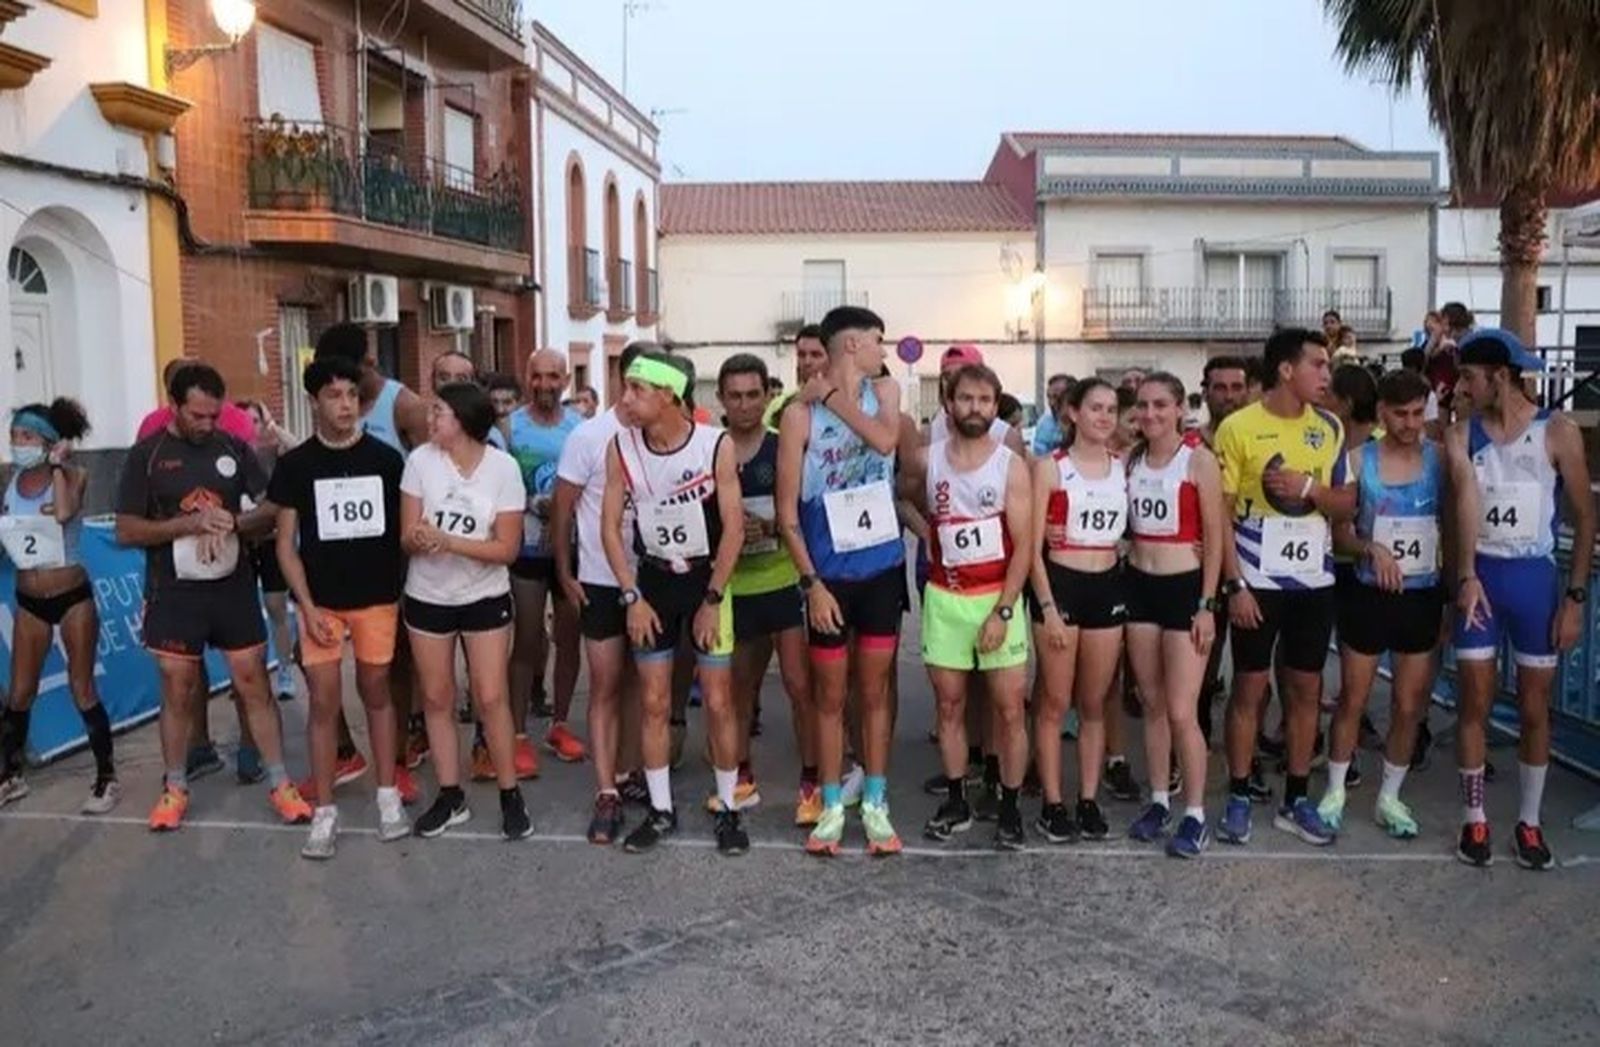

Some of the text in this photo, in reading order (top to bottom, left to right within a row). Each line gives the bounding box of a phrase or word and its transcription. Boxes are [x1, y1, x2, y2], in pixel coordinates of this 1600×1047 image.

[329, 499, 375, 523] 180
[857, 509, 873, 531] 4
[1079, 509, 1121, 531] 187
[1131, 496, 1170, 522] 190
[1483, 505, 1519, 529] 44
[434, 510, 478, 535] 179
[23, 534, 38, 556] 2
[655, 525, 689, 547] 36
[954, 526, 983, 550] 61
[1279, 540, 1310, 562] 46
[1391, 537, 1424, 561] 54
